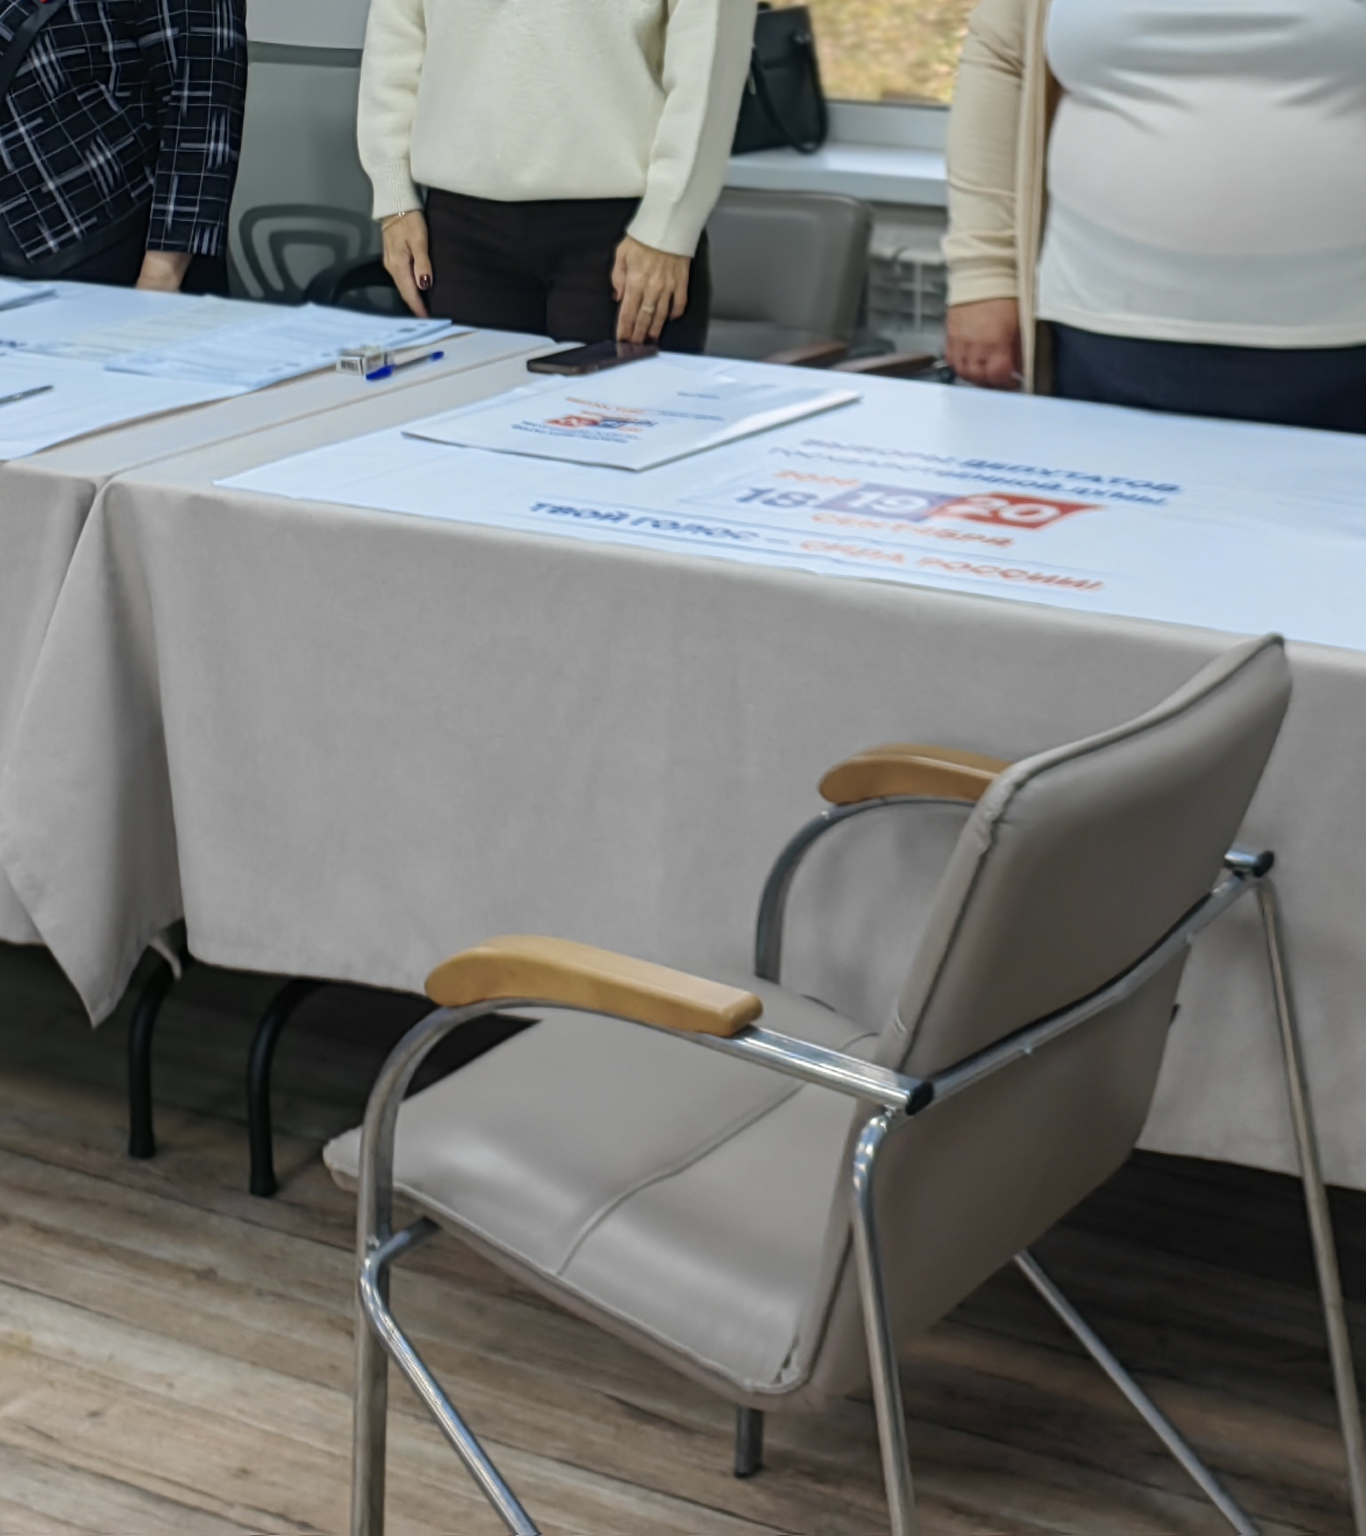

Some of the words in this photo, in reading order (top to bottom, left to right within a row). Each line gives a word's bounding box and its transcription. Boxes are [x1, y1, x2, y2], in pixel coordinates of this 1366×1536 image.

[959, 460, 1180, 492] ДЕПУТАТОВ
[735, 488, 818, 508] 18
[847, 492, 930, 514] 19
[939, 496, 1061, 523] 20
[531, 502, 630, 523] ТВОЙ
[630, 516, 761, 541] ГОЛОС
[801, 541, 905, 566] СИЛА
